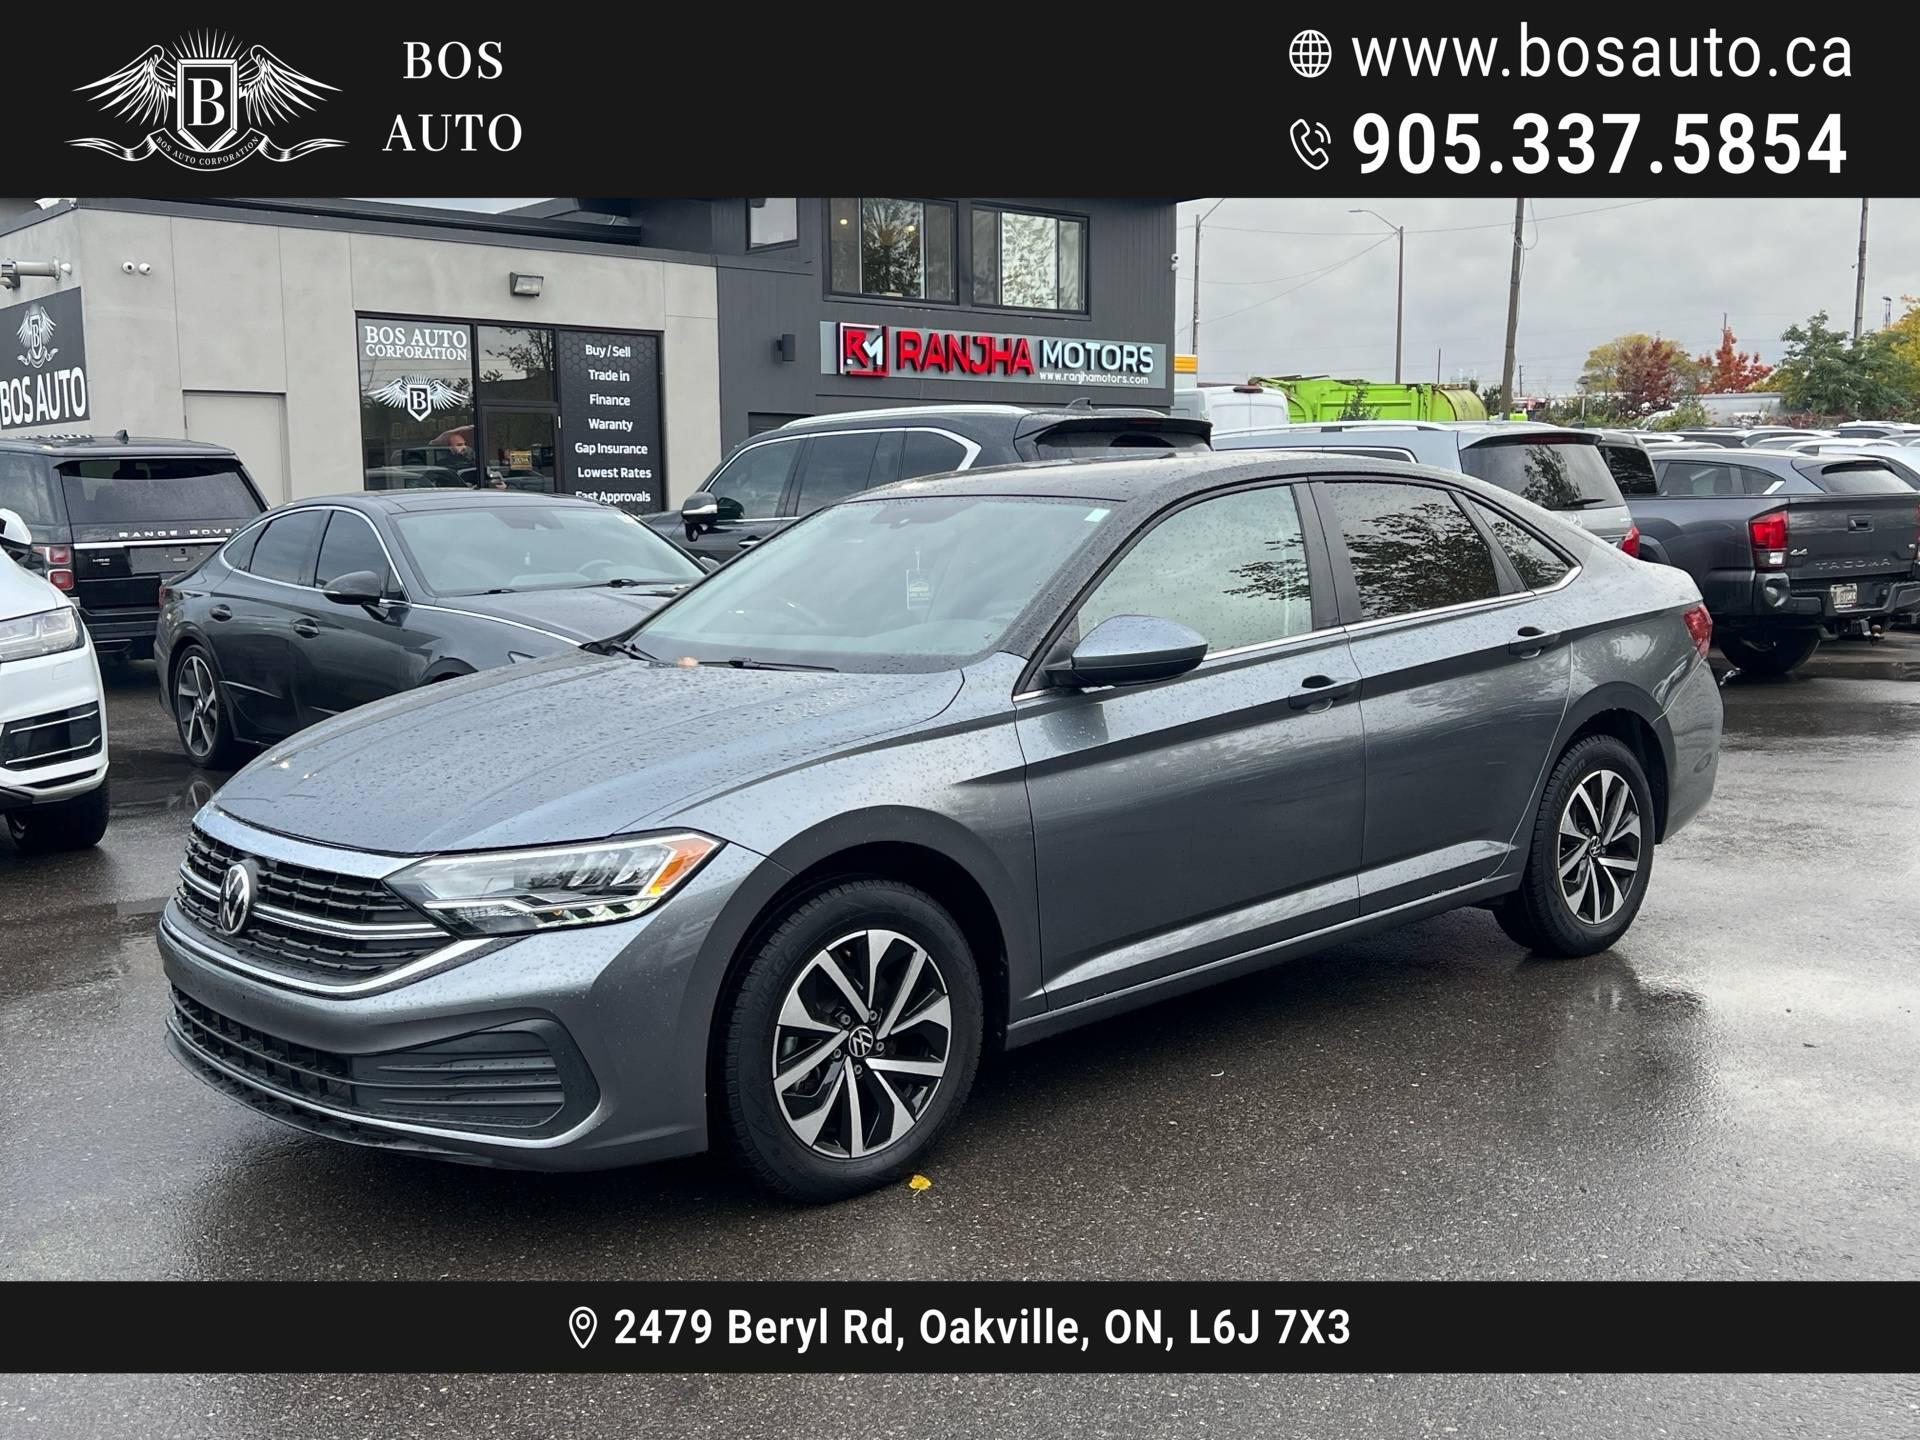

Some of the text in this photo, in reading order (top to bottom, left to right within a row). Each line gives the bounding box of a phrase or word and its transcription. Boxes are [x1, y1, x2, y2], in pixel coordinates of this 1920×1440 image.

[364, 325, 467, 348] BOS AUTO
[366, 343, 467, 360] CORPORATION
[585, 344, 606, 358] Buy
[612, 345, 631, 357] Sell
[896, 330, 1035, 375] RANJHA
[1040, 339, 1154, 374] MOTORS
[588, 369, 630, 382] Trade in
[1040, 371, 1149, 385] www.ranjhamotors.com
[0, 366, 87, 426] BOS AUTO
[411, 390, 427, 410] B
[589, 393, 631, 406] Finance
[588, 418, 633, 432] Waranty
[575, 442, 648, 455] Gap Insurance
[577, 466, 652, 478] Lowest Rates
[599, 490, 651, 504] Approvals
[119, 527, 240, 538] RANGE ROVE
